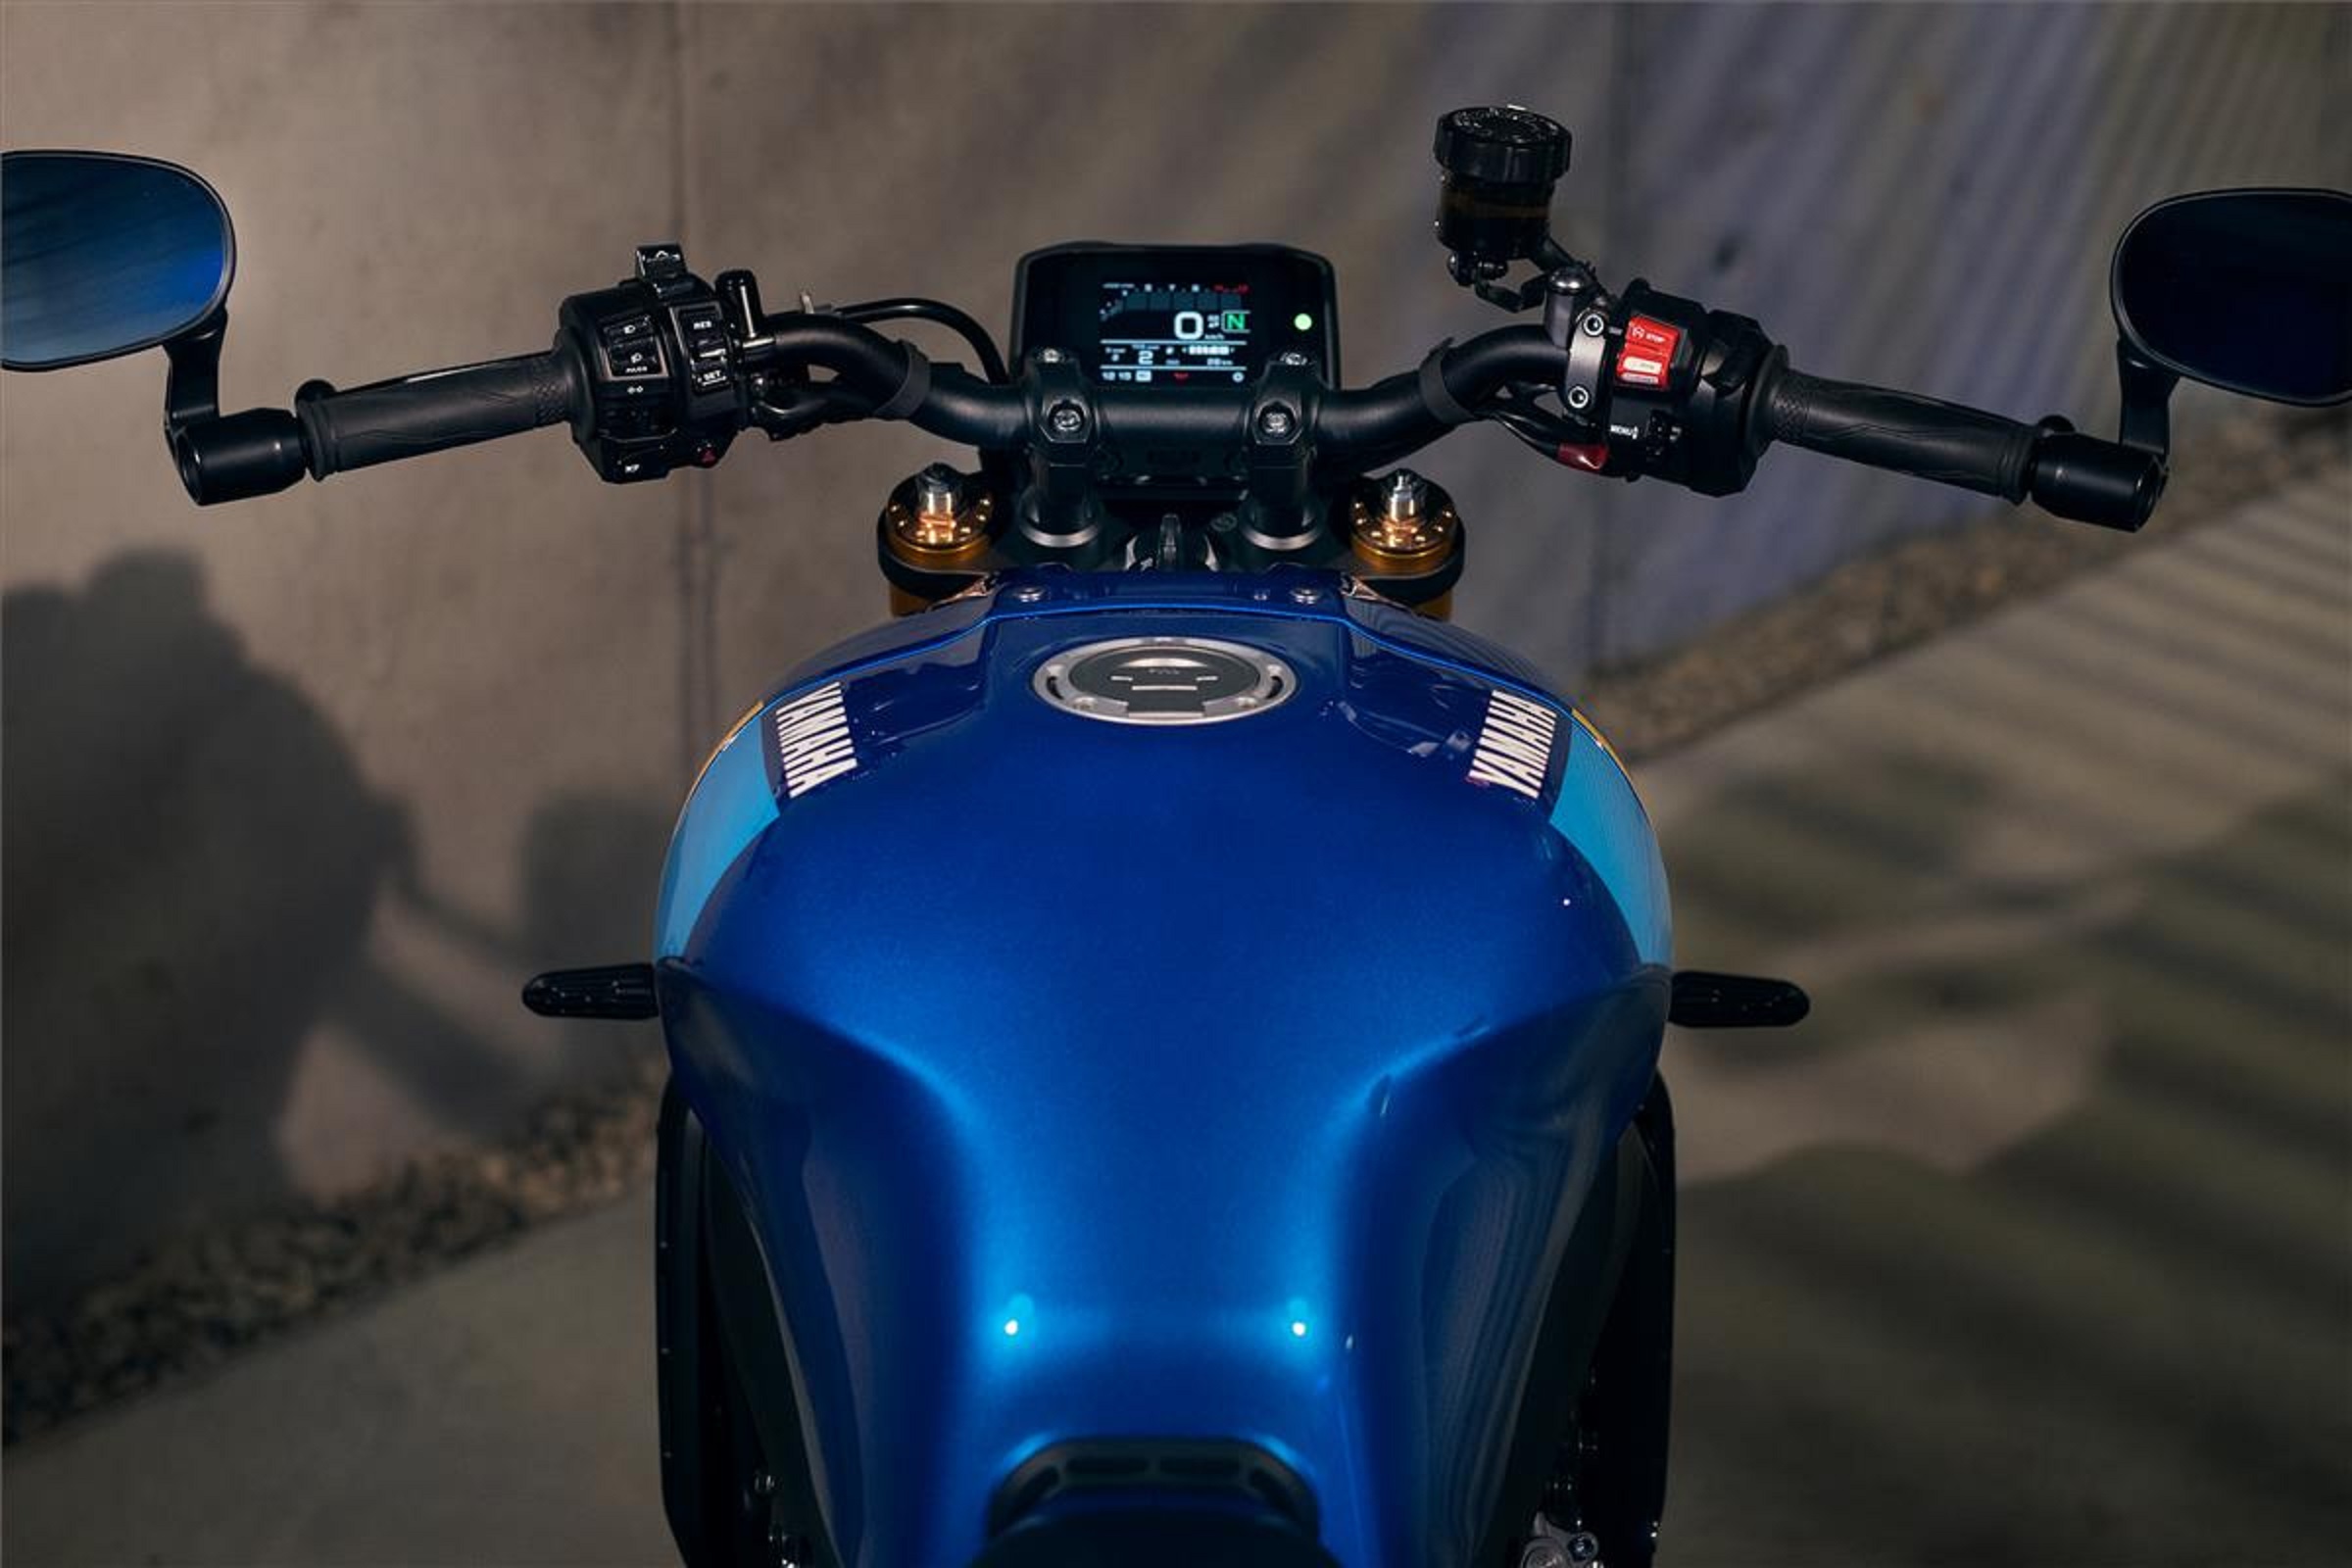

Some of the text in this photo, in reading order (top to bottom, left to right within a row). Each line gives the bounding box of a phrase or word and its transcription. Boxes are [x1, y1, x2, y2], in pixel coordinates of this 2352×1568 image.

[1174, 312, 1203, 340] 0
[1227, 314, 1246, 330] N
[1138, 351, 1153, 366] 2
[775, 681, 858, 799] YAMAHA
[1468, 689, 1557, 799] YAMAHA
